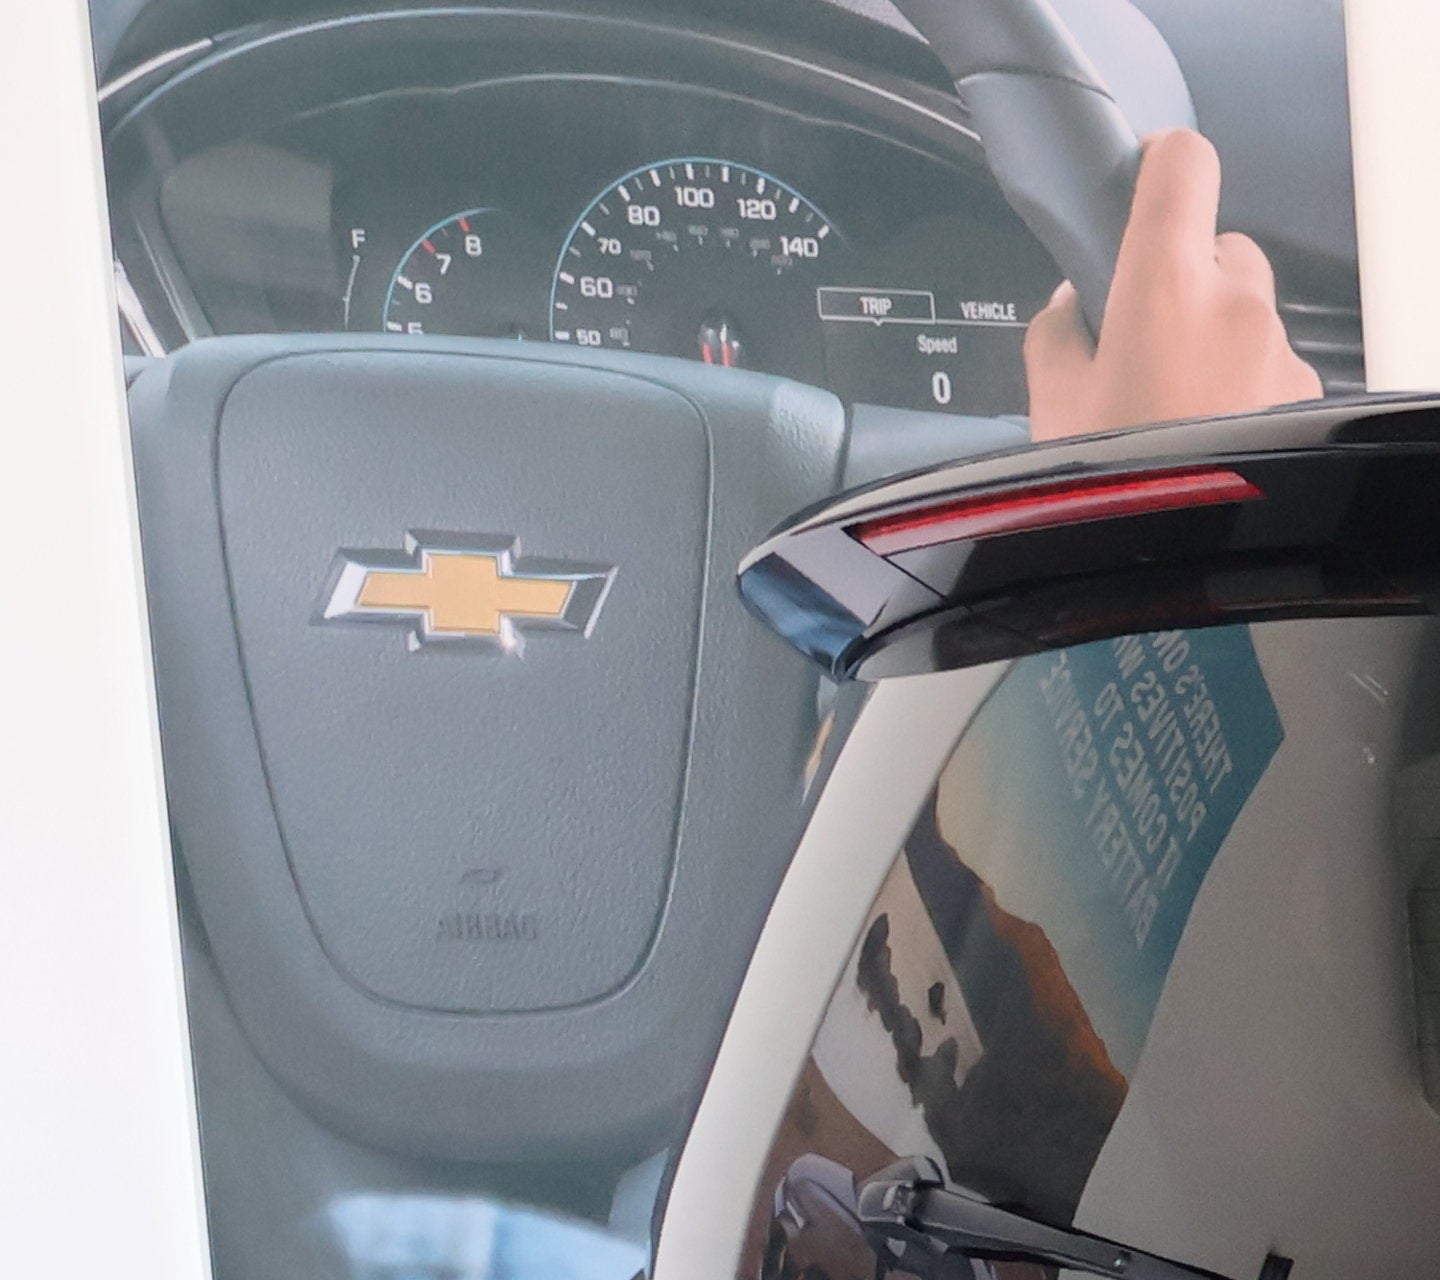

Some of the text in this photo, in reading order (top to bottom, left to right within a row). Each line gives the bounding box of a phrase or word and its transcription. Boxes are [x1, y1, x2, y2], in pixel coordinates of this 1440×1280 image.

[674, 186, 714, 208] 100
[627, 205, 660, 226] 80
[736, 198, 776, 220] 120
[351, 229, 365, 249] F
[464, 235, 482, 256] 8
[597, 238, 621, 255] 70
[779, 236, 819, 257] 140
[435, 253, 451, 275] 7
[414, 282, 432, 304] 6
[580, 277, 613, 298] 60
[860, 296, 1017, 321] TRIP VEHICLE
[576, 329, 600, 346] 50
[917, 333, 958, 355] Speed
[931, 371, 952, 405] 0
